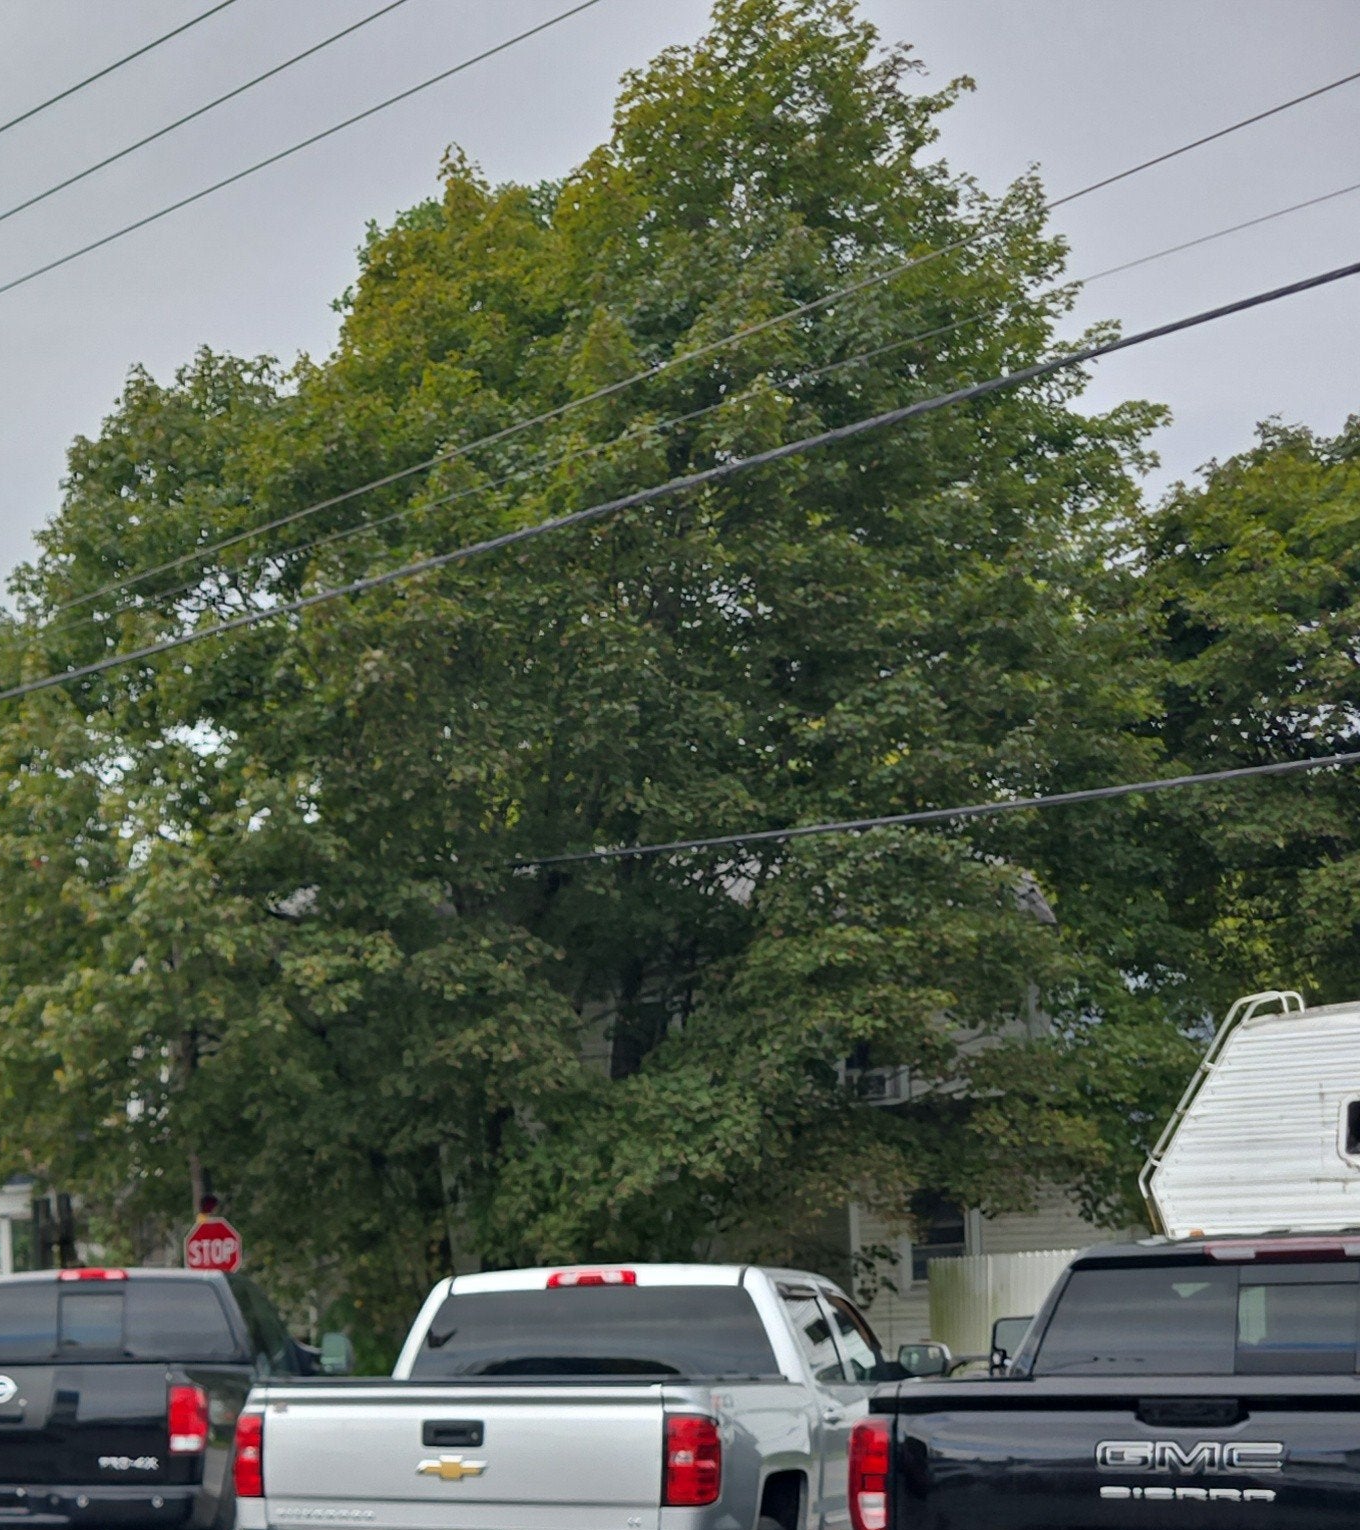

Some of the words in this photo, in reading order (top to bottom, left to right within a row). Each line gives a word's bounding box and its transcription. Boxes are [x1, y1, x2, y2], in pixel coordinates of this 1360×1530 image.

[188, 1237, 237, 1266] STOP
[1096, 1440, 1283, 1475] GMC
[1099, 1486, 1276, 1502] SIERRA
